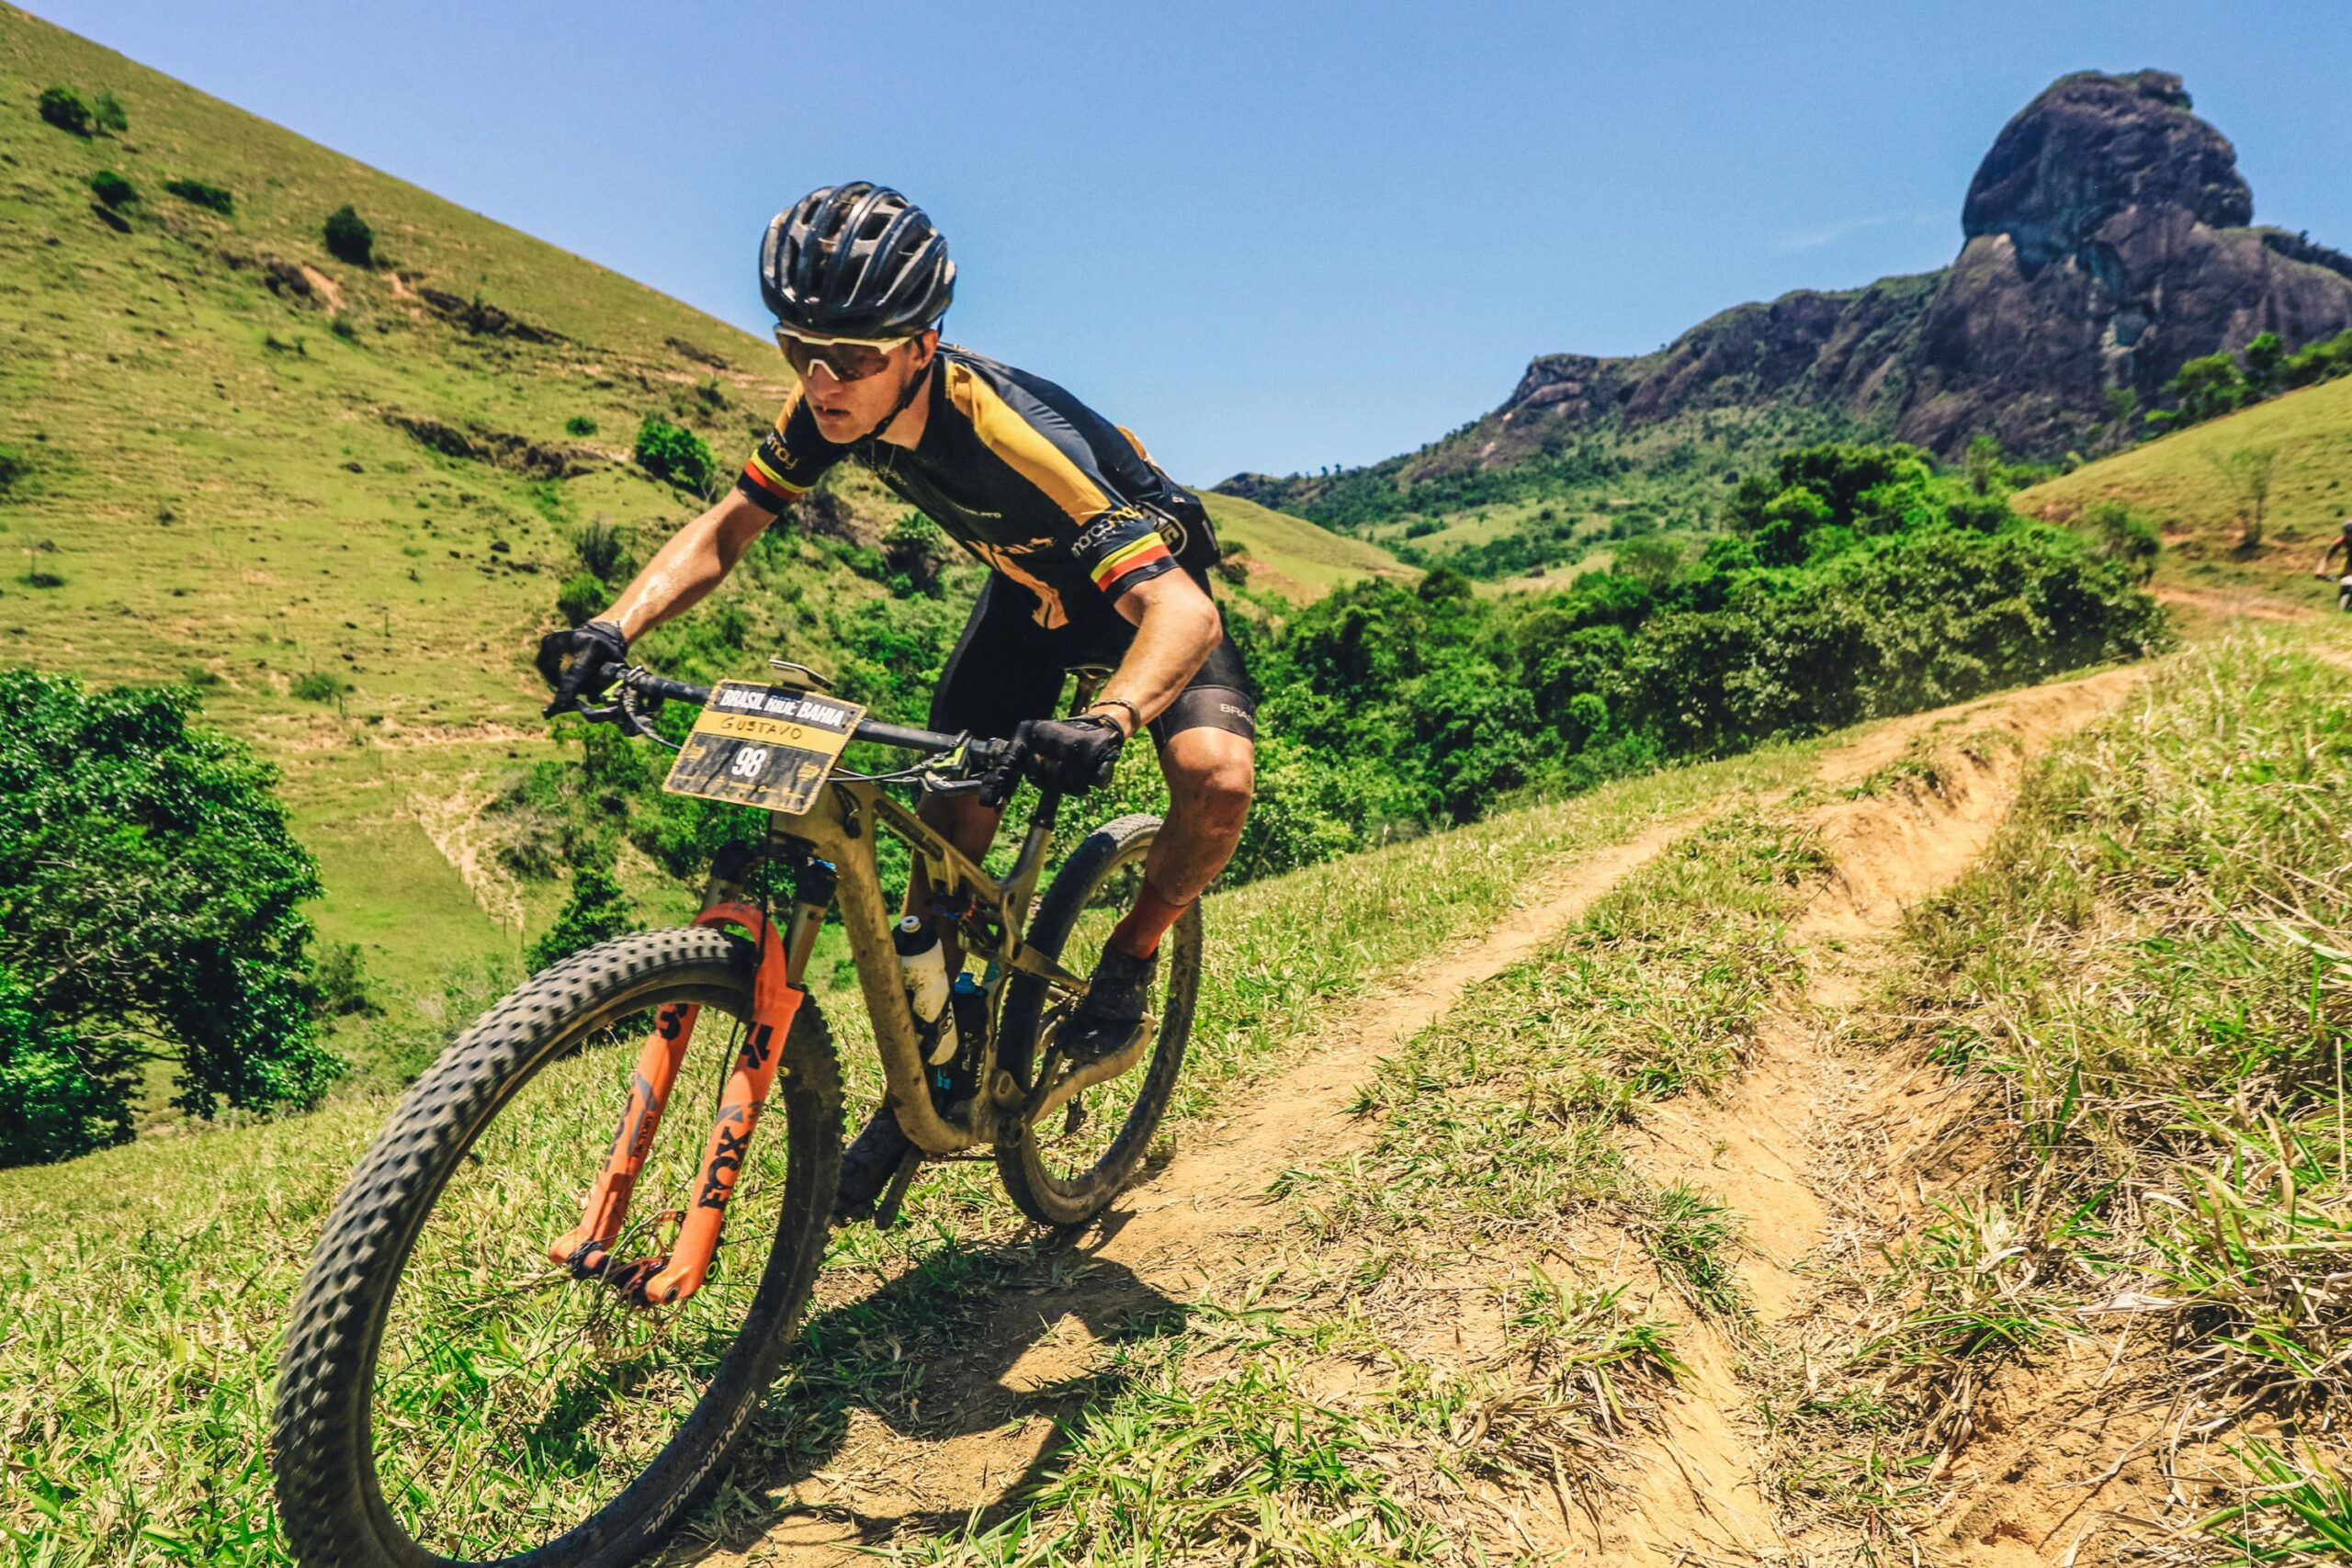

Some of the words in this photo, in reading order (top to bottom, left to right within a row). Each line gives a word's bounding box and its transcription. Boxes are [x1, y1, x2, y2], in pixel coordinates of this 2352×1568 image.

[719, 689, 766, 710] BRASIL
[796, 702, 844, 727] BAHIA
[720, 716, 802, 739] GUSTAVO
[731, 747, 768, 777] 98
[698, 1126, 752, 1212] FOX
[643, 1391, 756, 1535] CONTINENTAL
